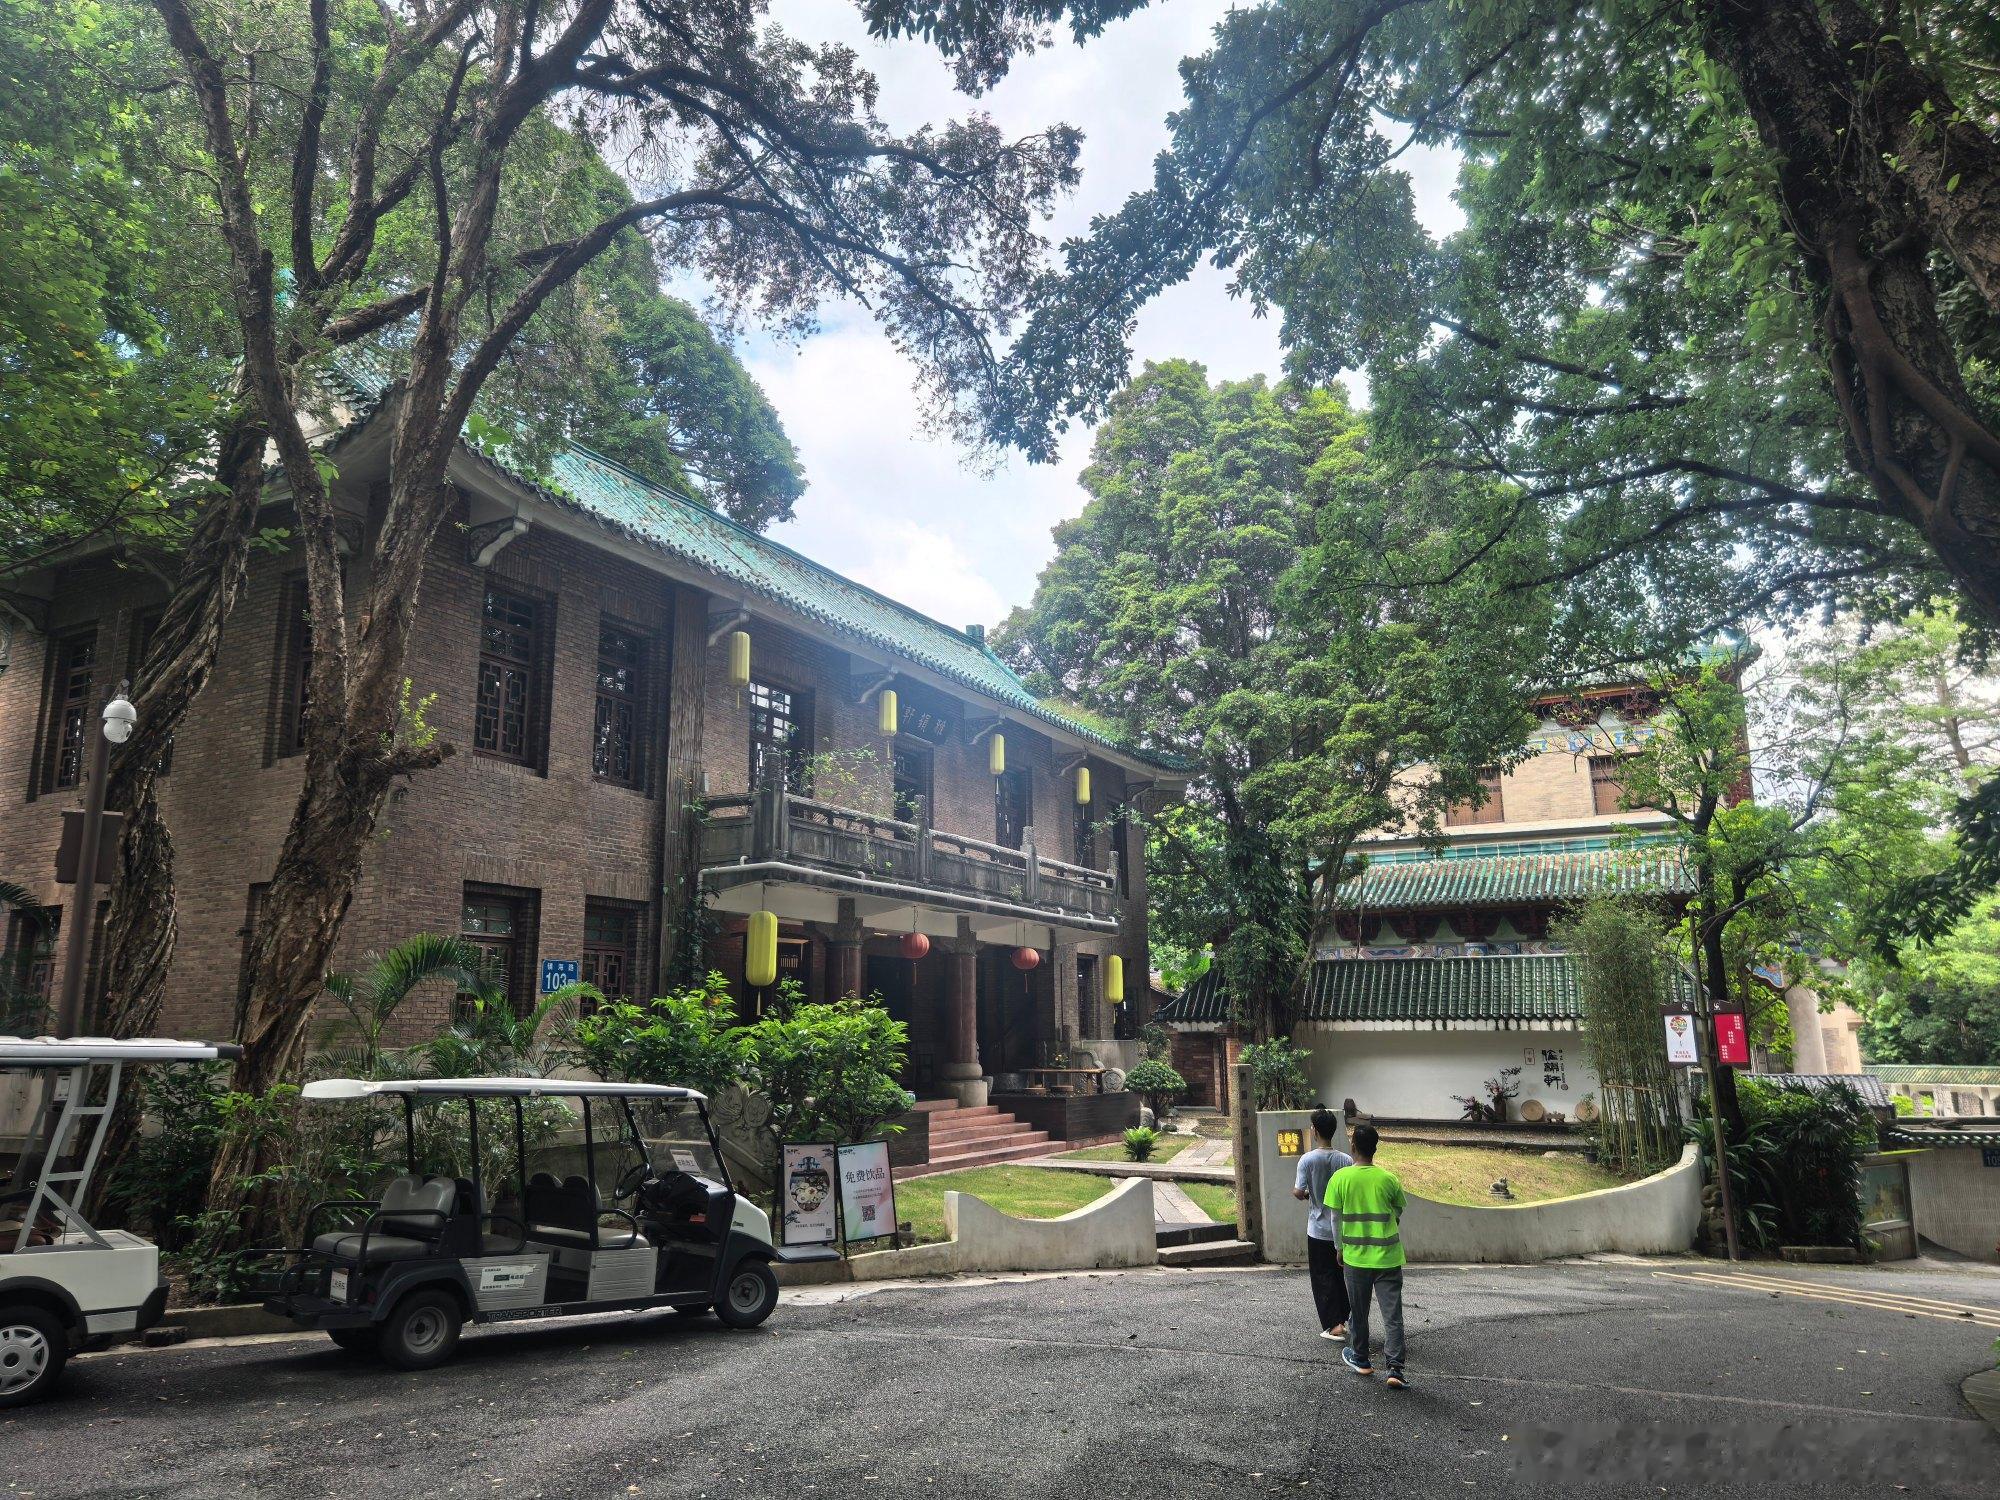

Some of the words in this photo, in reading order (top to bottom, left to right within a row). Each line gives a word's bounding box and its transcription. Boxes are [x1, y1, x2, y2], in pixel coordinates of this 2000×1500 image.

[845, 1167, 885, 1184] 免费饮品
[487, 1307, 563, 1321] TRANSPORTER
